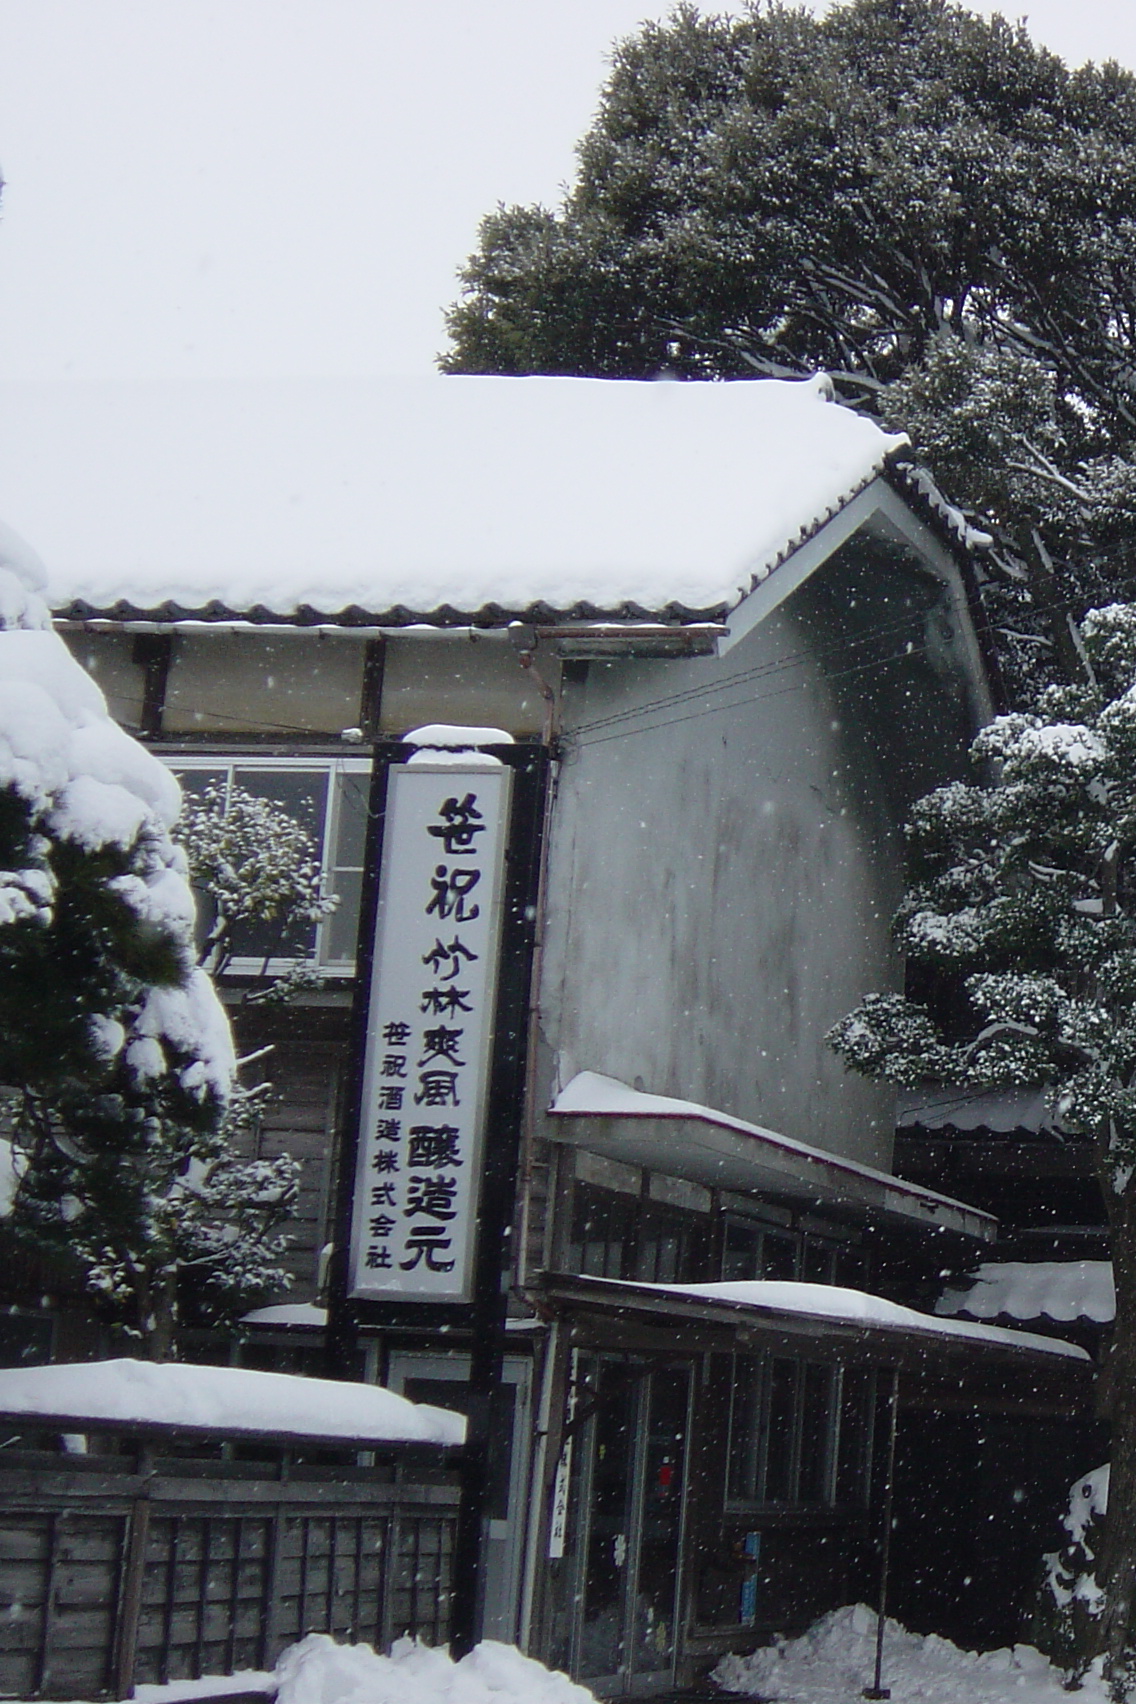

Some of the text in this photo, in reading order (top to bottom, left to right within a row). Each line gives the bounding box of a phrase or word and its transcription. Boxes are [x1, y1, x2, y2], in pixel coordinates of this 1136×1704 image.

[365, 1021, 411, 1269] 笹祝酒造株式会社
